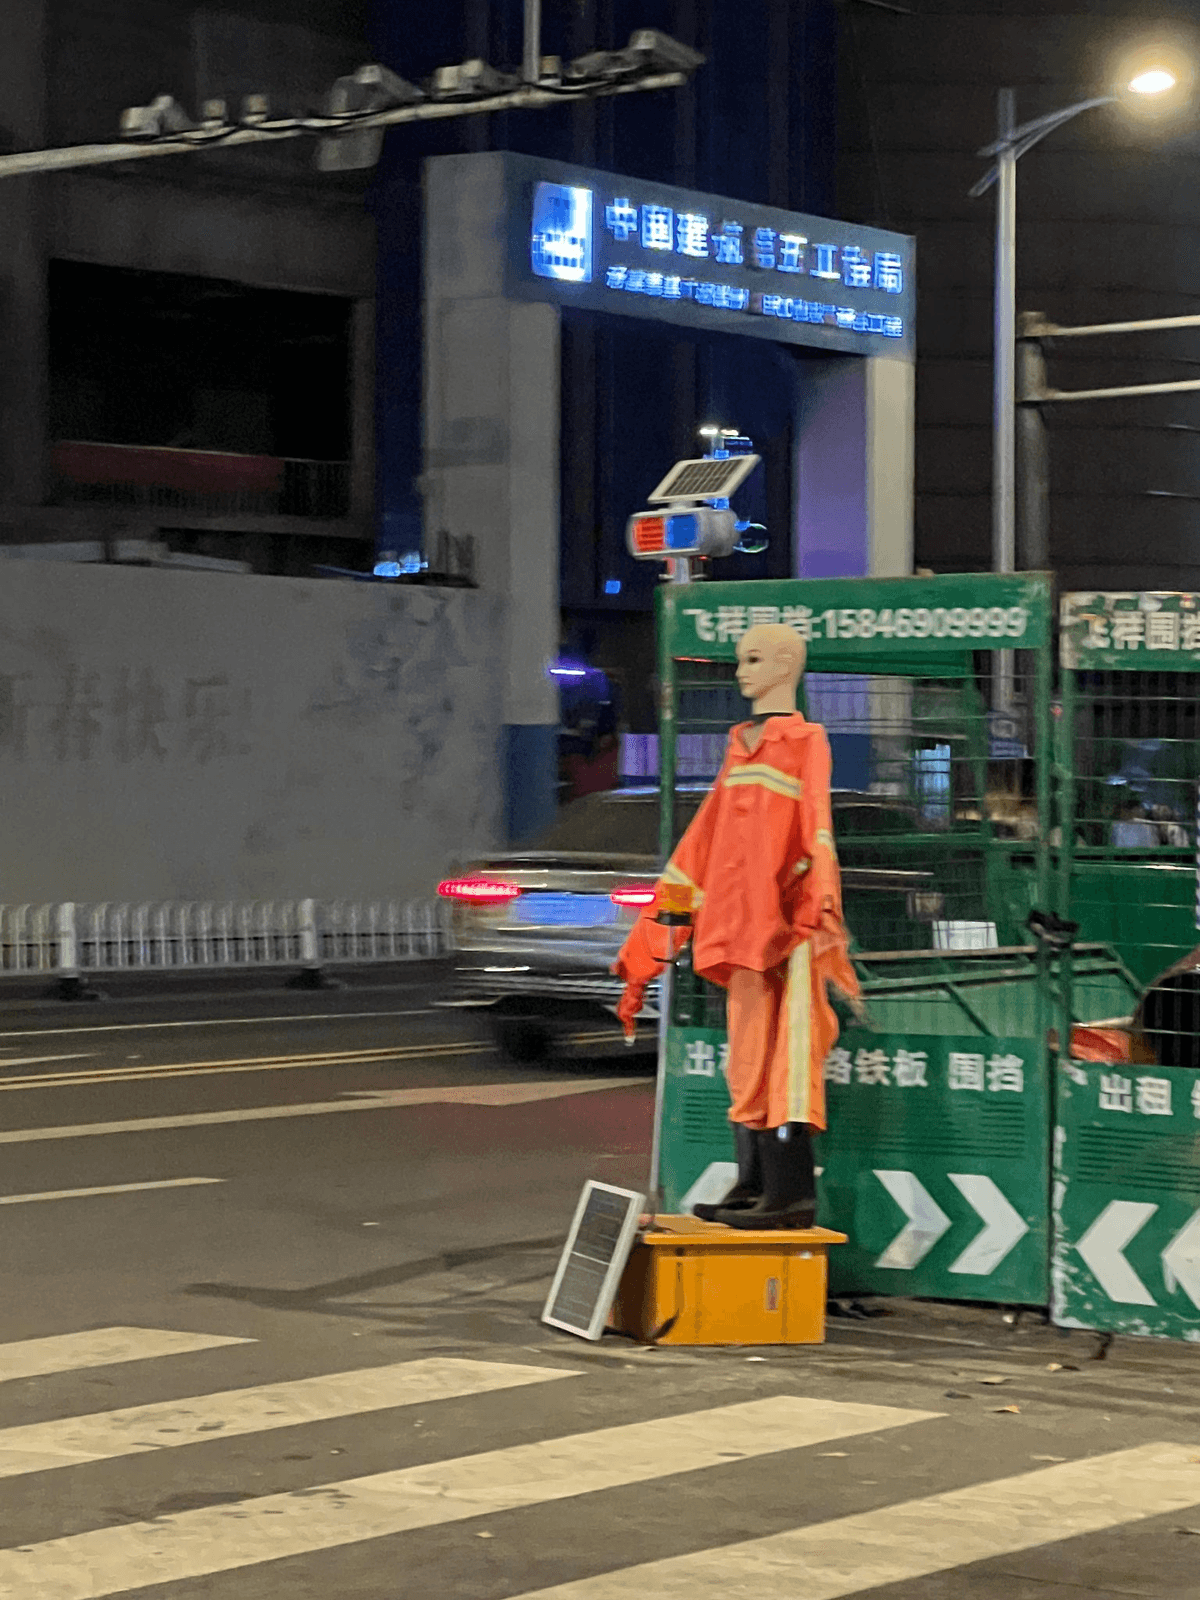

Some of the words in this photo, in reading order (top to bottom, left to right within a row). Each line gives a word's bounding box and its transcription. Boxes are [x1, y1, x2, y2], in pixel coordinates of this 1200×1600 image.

[684, 1039, 731, 1077] 出
[948, 1052, 1025, 1092] 围挡
[1098, 1073, 1174, 1116] 出租
